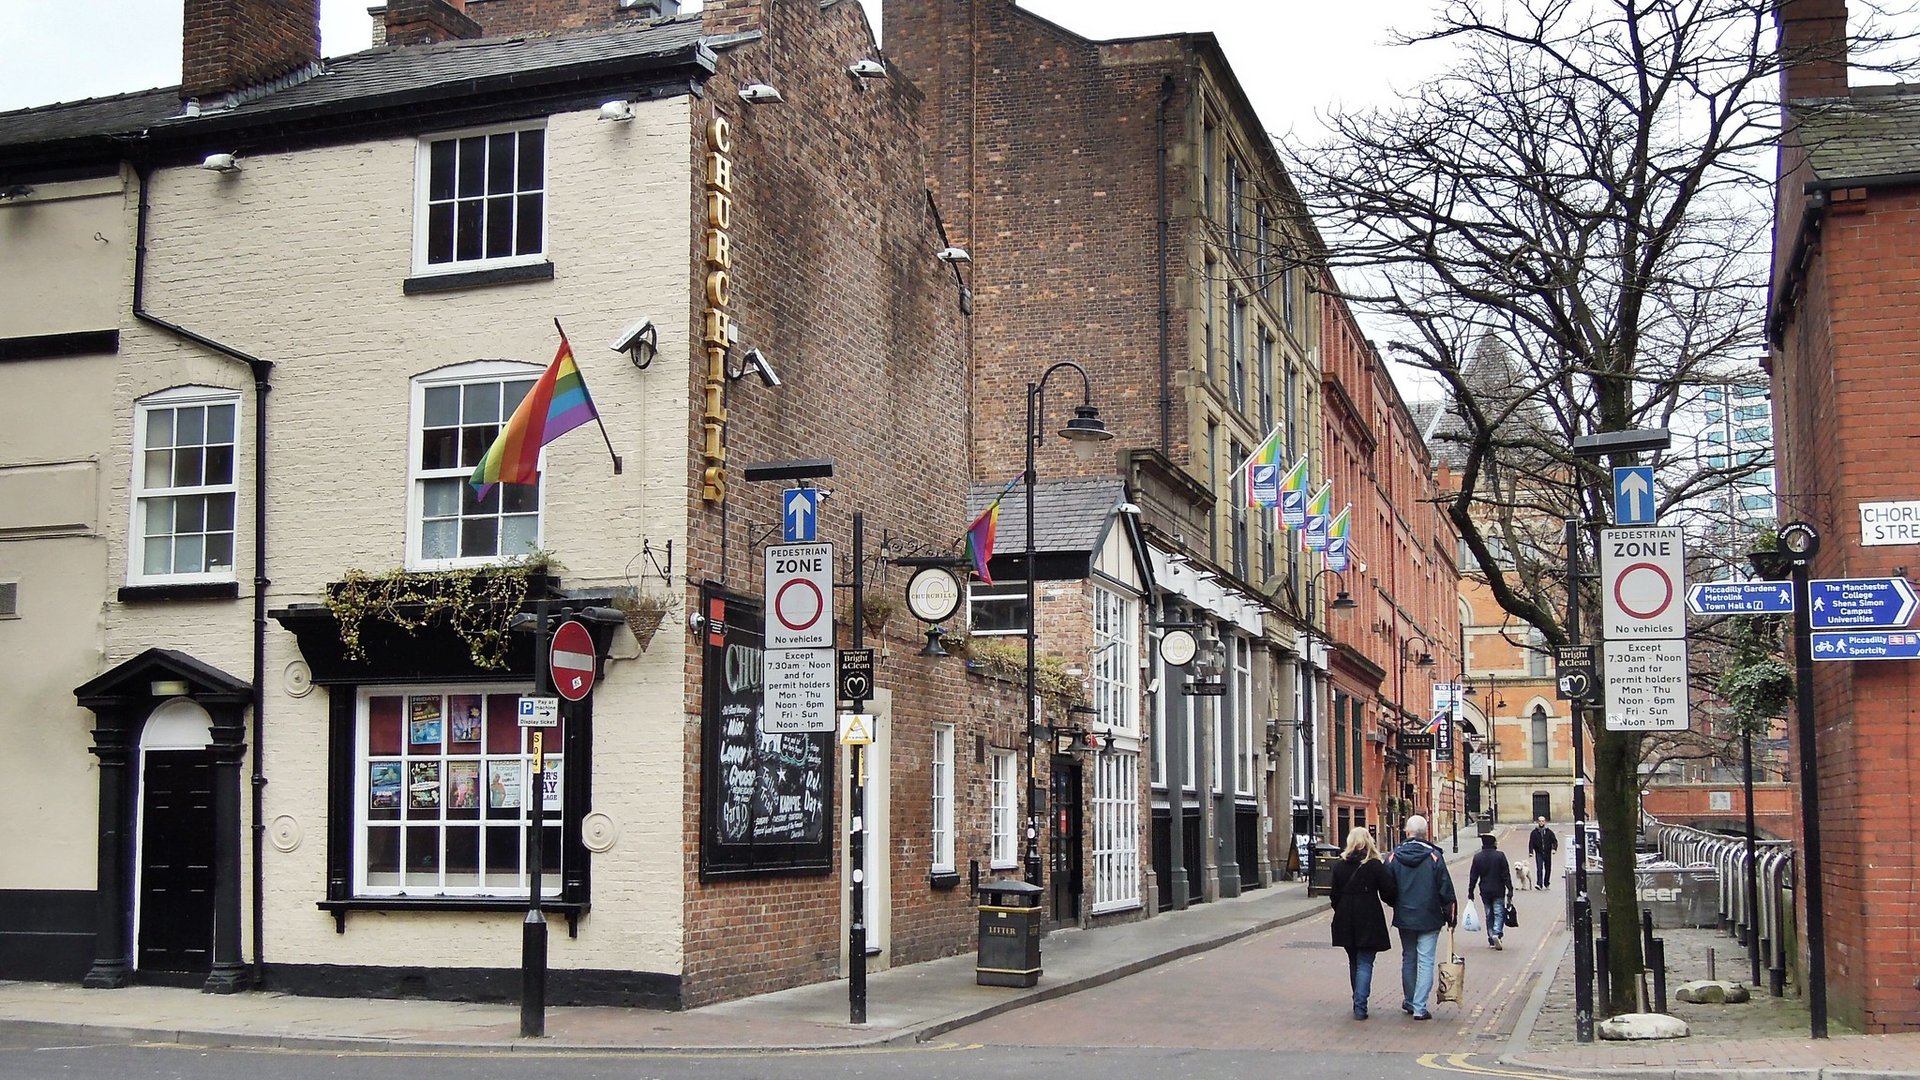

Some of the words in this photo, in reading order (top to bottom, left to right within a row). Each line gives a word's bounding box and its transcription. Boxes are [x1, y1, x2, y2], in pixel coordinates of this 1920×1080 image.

[703, 117, 731, 501] CHURCHILLS
[1608, 530, 1676, 540] PEDESTRIAN
[1780, 524, 1800, 539] Chorlton
[1801, 524, 1816, 538] Street
[1875, 524, 1920, 539] STRE
[771, 547, 827, 557] PEDESTRIAN
[1614, 542, 1671, 557] ZONE
[776, 558, 822, 573] ZONE
[1704, 586, 1742, 594] Piccadilly
[1743, 585, 1777, 593] Gardens
[1842, 592, 1873, 600] College
[1859, 599, 1884, 607] Simon
[1827, 615, 1874, 623] Universities
[1616, 625, 1629, 633] No
[1633, 624, 1673, 632] vehicles
[790, 635, 822, 643] vehicles
[1849, 636, 1887, 644] Piccadilly
[1628, 644, 1661, 653] Except
[1849, 647, 1887, 655] Sportcity
[785, 652, 814, 660] Except
[844, 654, 868, 663] Bright
[1560, 651, 1588, 660] Bright
[1608, 654, 1645, 663] 7.30am
[1656, 654, 1681, 662] Noon
[768, 662, 800, 670] 7.30am
[809, 661, 831, 669] Noon
[1628, 665, 1646, 673] and
[784, 672, 800, 680] and
[1610, 676, 1642, 685] permit
[1645, 675, 1681, 683] holders
[769, 682, 796, 690] permit
[799, 681, 831, 689] holders
[1622, 686, 1642, 694] Mon
[1652, 685, 1671, 694] Thu
[779, 691, 796, 699] Mon
[775, 701, 797, 709] Noon
[806, 701, 825, 709] 6pm
[1618, 697, 1644, 705] Noon
[1654, 696, 1675, 706] 6pm
[801, 710, 818, 718] Sun
[1626, 707, 1639, 715] Fri
[1649, 707, 1668, 715] Sun
[776, 721, 798, 729] Noon
[807, 720, 824, 729] 1pm
[1620, 718, 1646, 726] Noon
[1656, 717, 1675, 727] 1pm
[1440, 716, 1448, 748] AURUS
[989, 927, 1017, 936] LITTER
